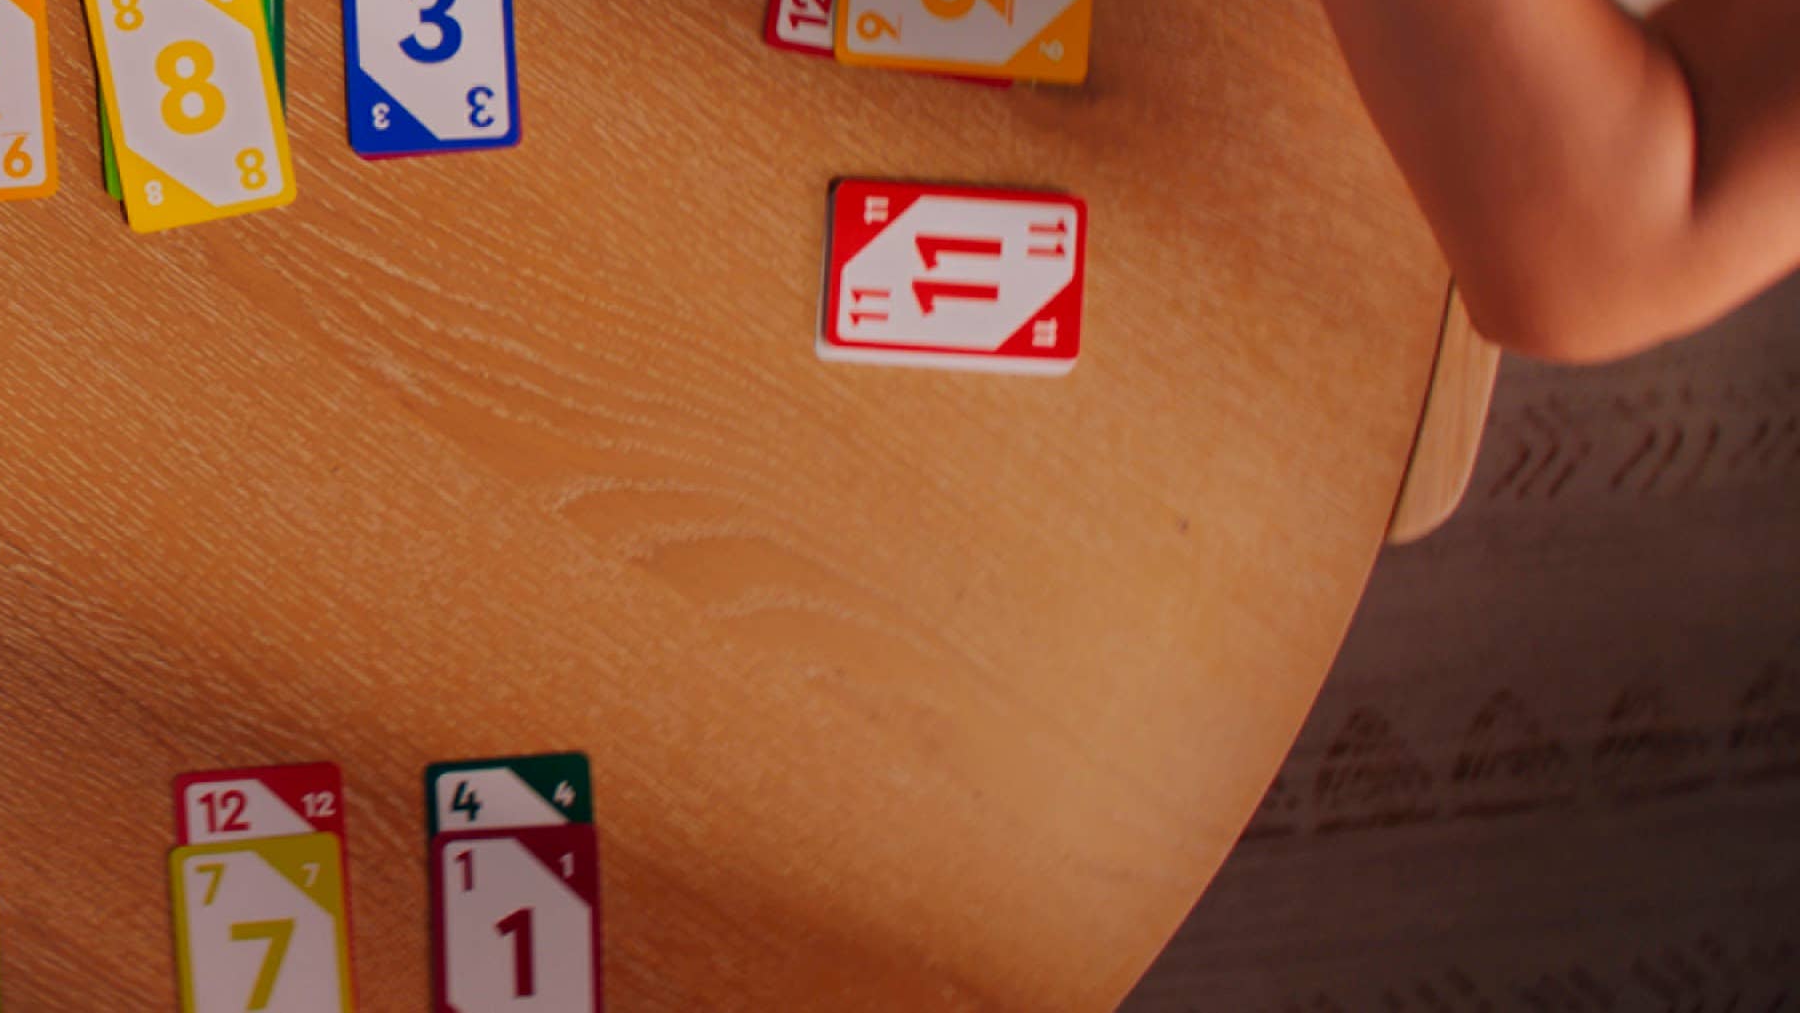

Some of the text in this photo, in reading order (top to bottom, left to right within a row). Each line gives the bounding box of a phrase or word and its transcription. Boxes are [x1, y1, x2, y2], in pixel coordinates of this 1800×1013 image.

[857, 11, 898, 42] 9
[154, 40, 225, 135] 8
[466, 86, 495, 127] 3
[371, 102, 390, 130] 3
[234, 147, 267, 190] 8
[144, 180, 163, 206] 8
[1027, 218, 1067, 258] 11
[911, 233, 1002, 316] 11
[849, 289, 890, 327] 11
[198, 790, 250, 832] 12
[302, 791, 336, 819] 12
[450, 782, 481, 822] 4
[553, 781, 576, 807] 4
[194, 863, 225, 906] 7
[302, 863, 321, 886] 7
[455, 850, 474, 891] 1
[559, 852, 574, 877] 1
[229, 918, 294, 1012] 7
[495, 907, 536, 998] 1
